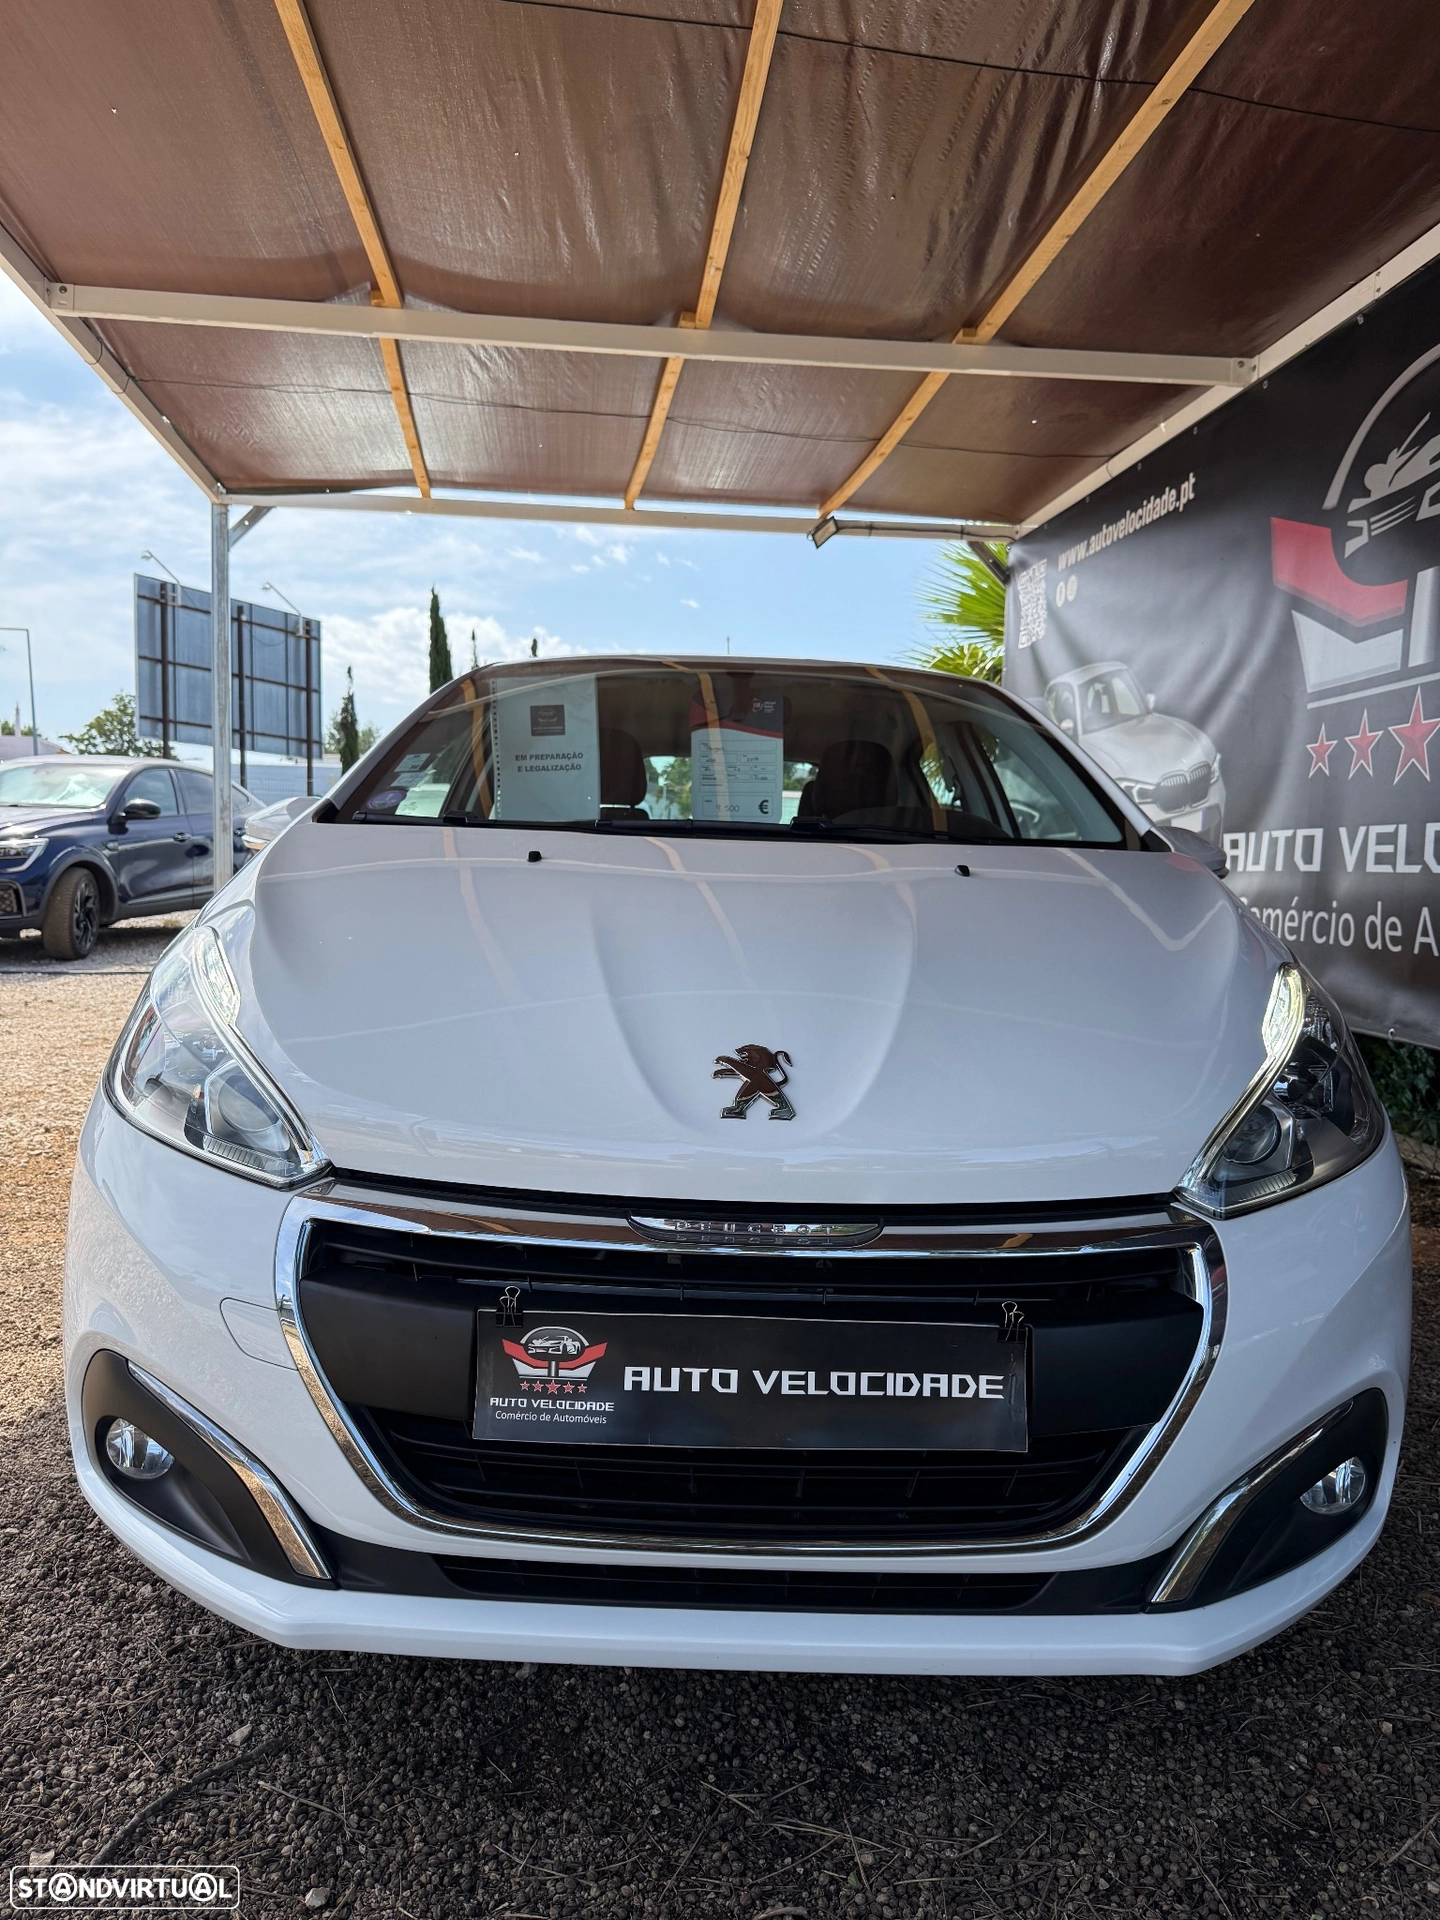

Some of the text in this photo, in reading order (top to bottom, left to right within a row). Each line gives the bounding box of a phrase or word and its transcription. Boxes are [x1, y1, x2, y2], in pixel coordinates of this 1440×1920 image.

[1058, 472, 1196, 572] www.autovelocidade.pt
[515, 751, 584, 762] EM PREPARAÇÃO
[517, 763, 582, 773] E LEGALIZAÇÃO
[1223, 828, 1324, 872] AUTO
[1365, 901, 1403, 953] de
[623, 1366, 1004, 1399] AUTO VELOCIDADE
[489, 1397, 615, 1412] AUTO VELOCIDADE
[495, 1410, 607, 1424] Comércio de Automóveis
